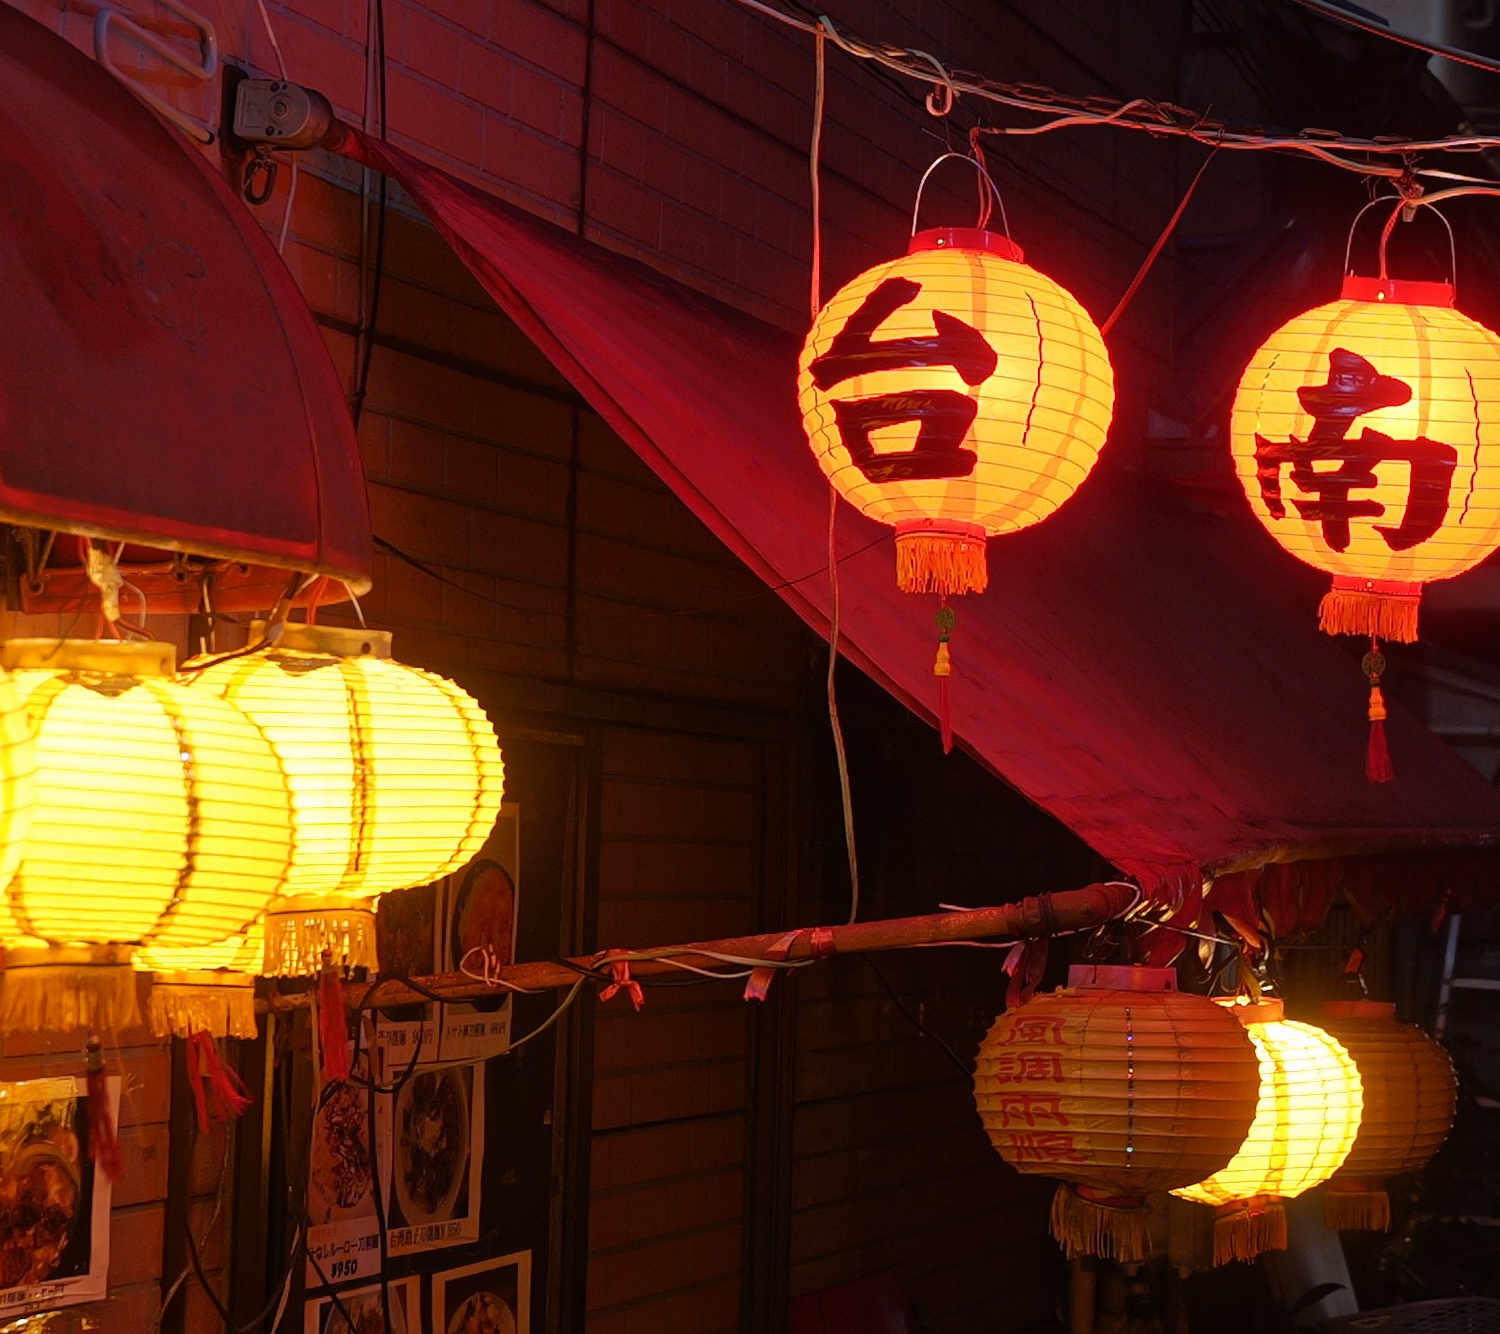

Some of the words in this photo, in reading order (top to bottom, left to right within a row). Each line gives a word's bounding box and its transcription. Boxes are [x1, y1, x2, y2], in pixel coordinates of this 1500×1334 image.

[809, 275, 1000, 483] 台
[1253, 346, 1460, 553] 南
[330, 1258, 358, 1279] ¥950
